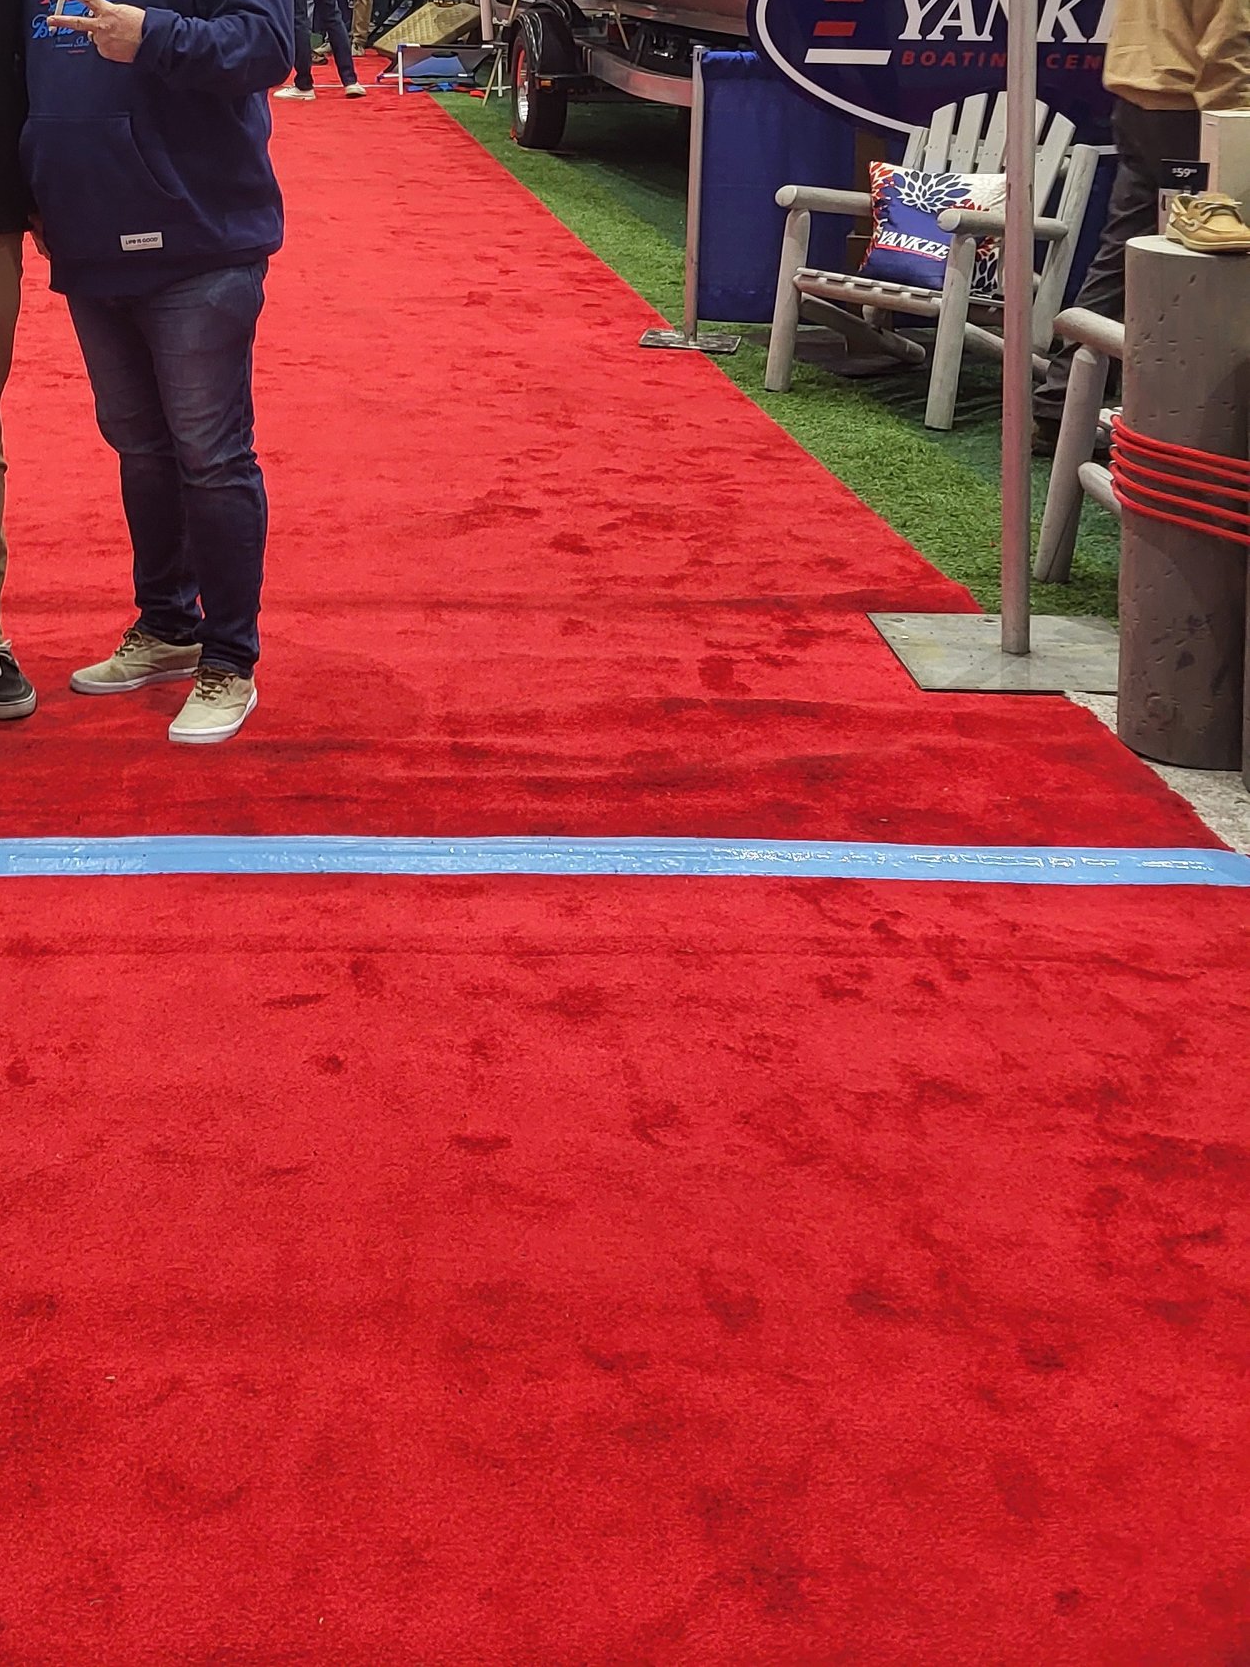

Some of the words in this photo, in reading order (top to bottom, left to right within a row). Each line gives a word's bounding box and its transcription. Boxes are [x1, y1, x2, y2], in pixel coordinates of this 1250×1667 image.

[902, 49, 1008, 68] BOATIN
[1046, 53, 1104, 70] CEN
[878, 231, 950, 260] YANKEE
